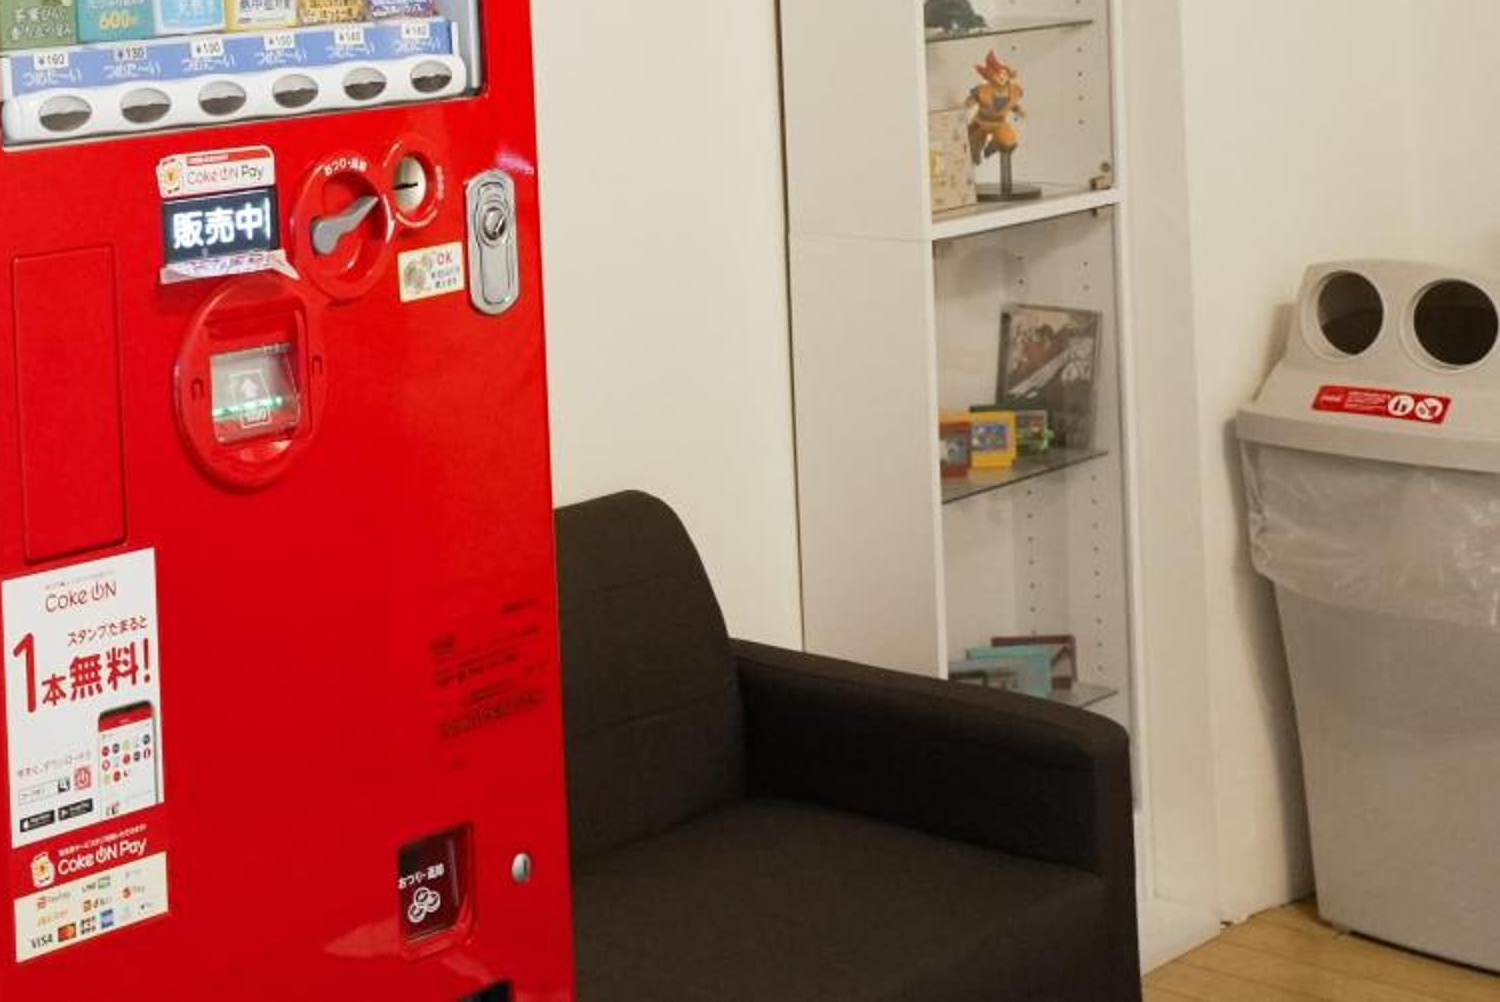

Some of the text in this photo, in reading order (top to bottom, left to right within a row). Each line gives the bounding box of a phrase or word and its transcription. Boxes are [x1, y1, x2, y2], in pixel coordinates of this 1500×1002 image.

[241, 164, 265, 180] Pay
[45, 581, 118, 613] Coke ON
[67, 615, 149, 647] スタンプたまると
[57, 852, 95, 875] Coke
[95, 843, 119, 865] ON
[119, 836, 148, 858] Pay
